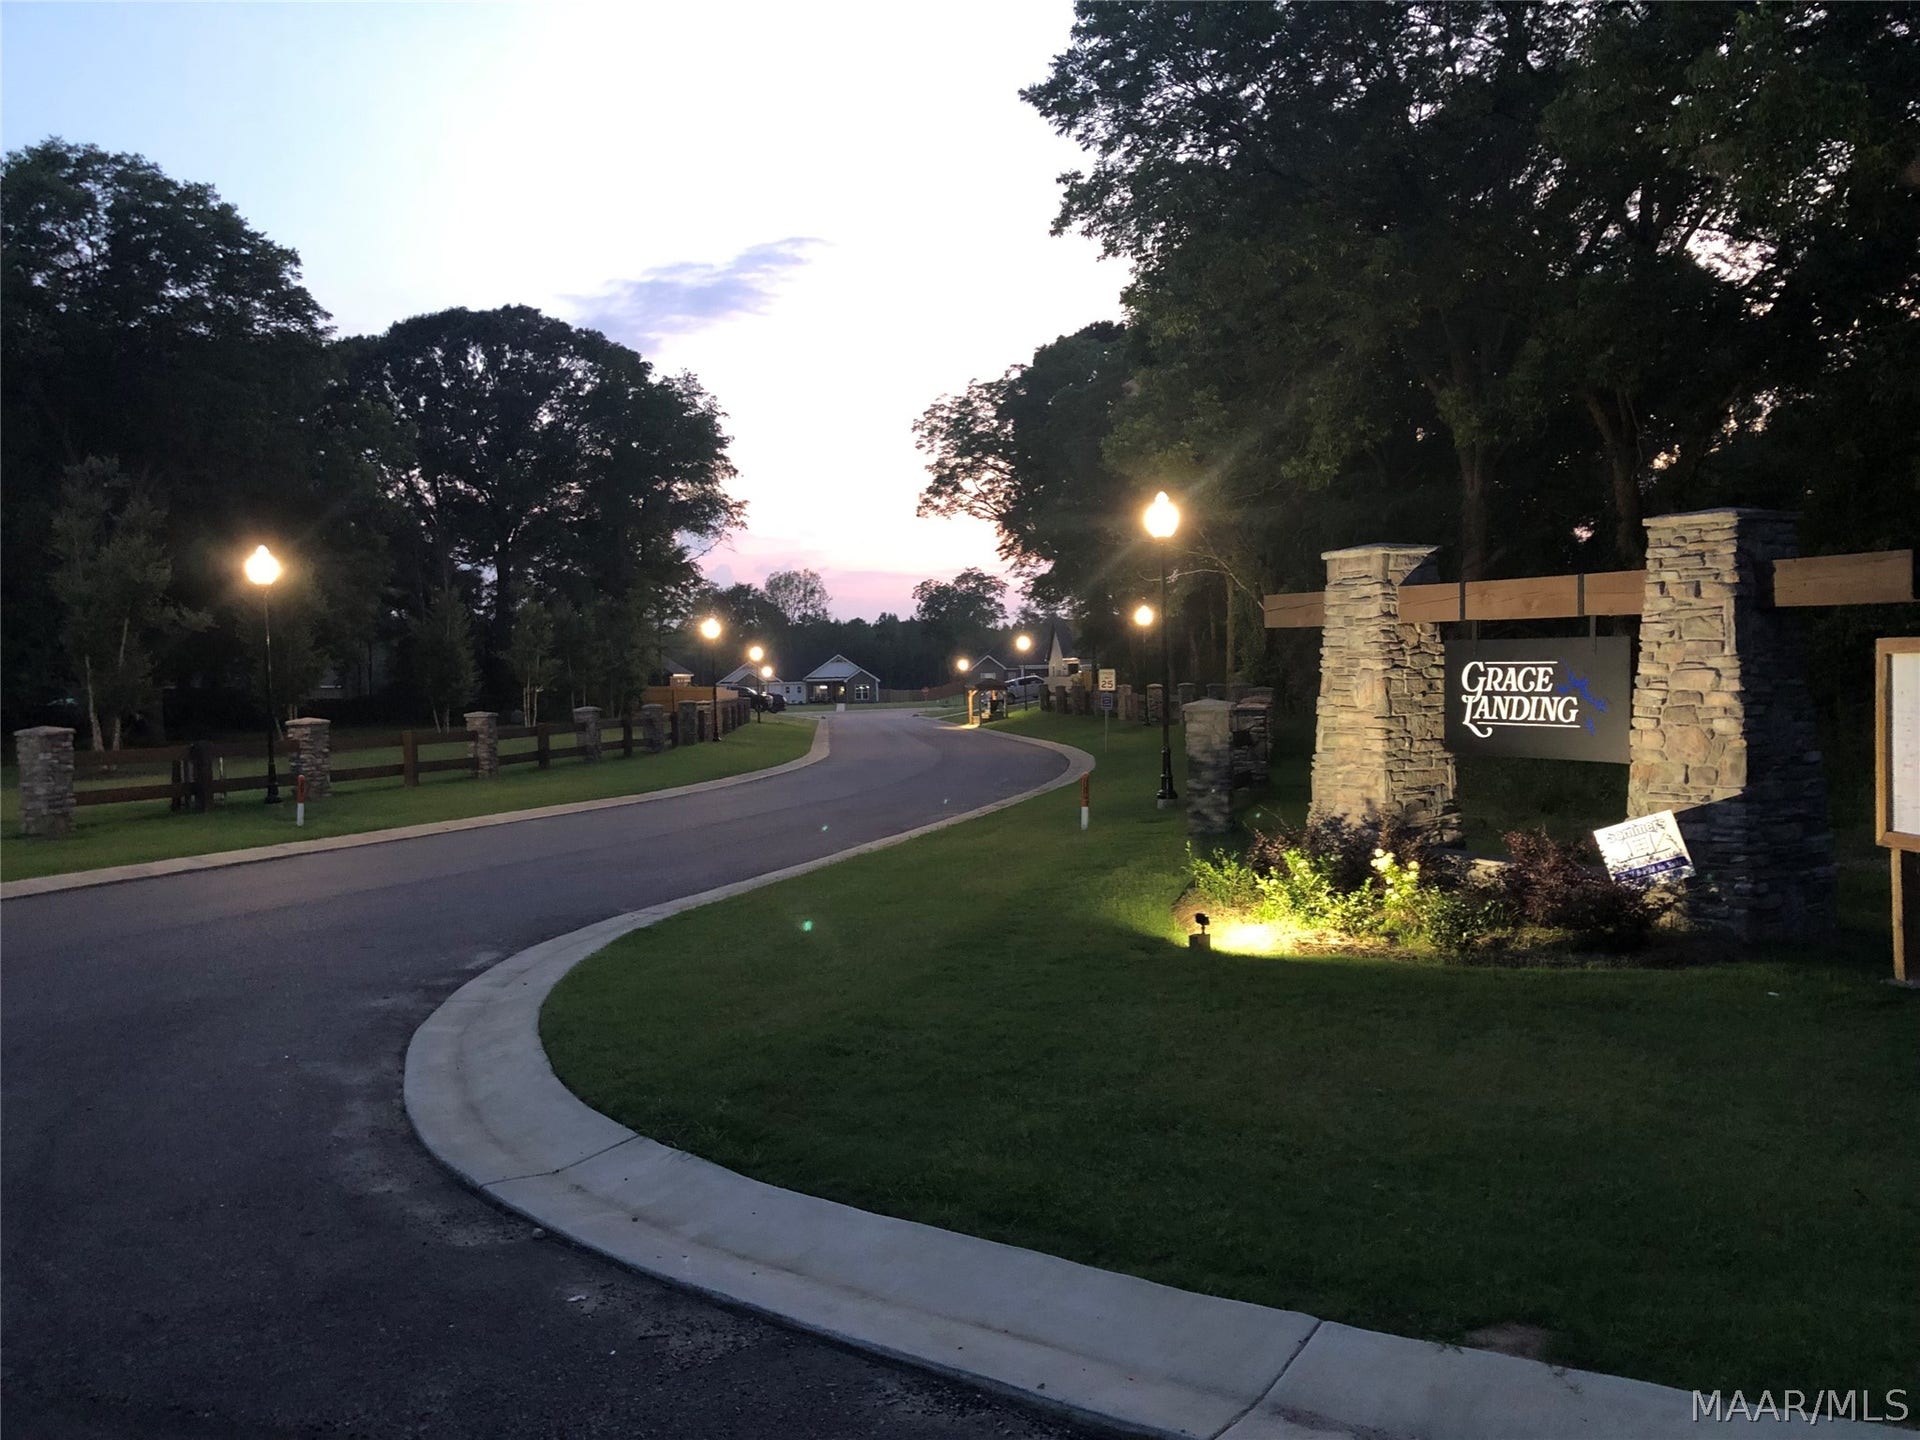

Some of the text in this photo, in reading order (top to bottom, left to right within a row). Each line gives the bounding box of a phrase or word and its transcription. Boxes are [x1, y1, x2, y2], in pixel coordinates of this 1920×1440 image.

[1101, 680, 1113, 689] 25
[1461, 661, 1553, 701] GRACE
[1461, 694, 1579, 737] LANDING
